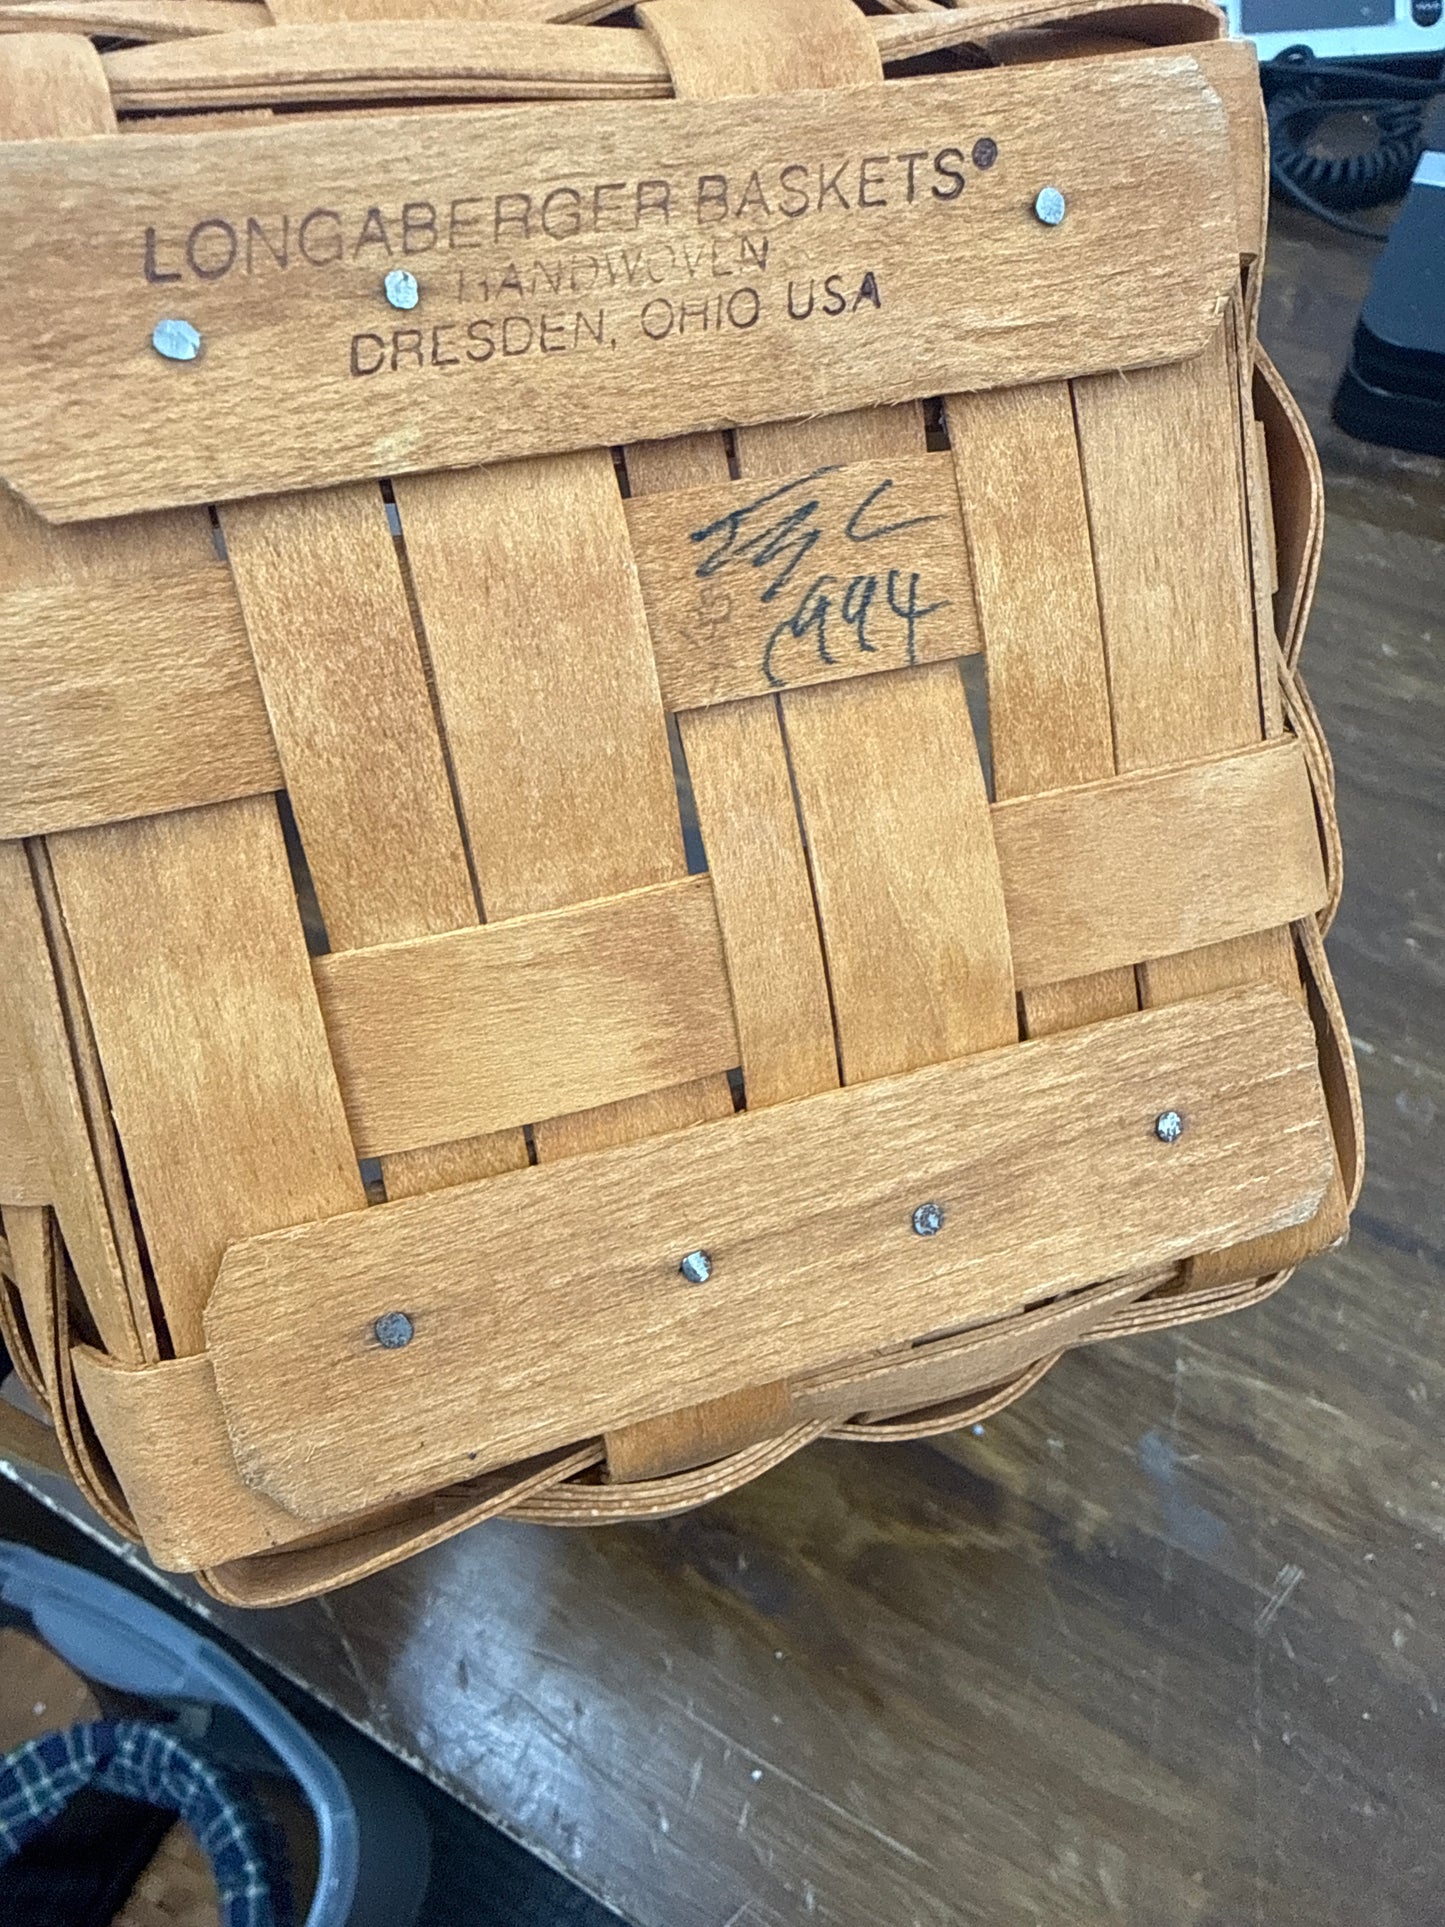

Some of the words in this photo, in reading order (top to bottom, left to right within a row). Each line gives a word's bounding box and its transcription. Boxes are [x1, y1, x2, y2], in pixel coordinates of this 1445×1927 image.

[143, 180, 672, 284] LONGABERGER
[350, 308, 617, 378] DRESDEN,
[640, 286, 761, 341] OHIO
[786, 271, 883, 321] USA
